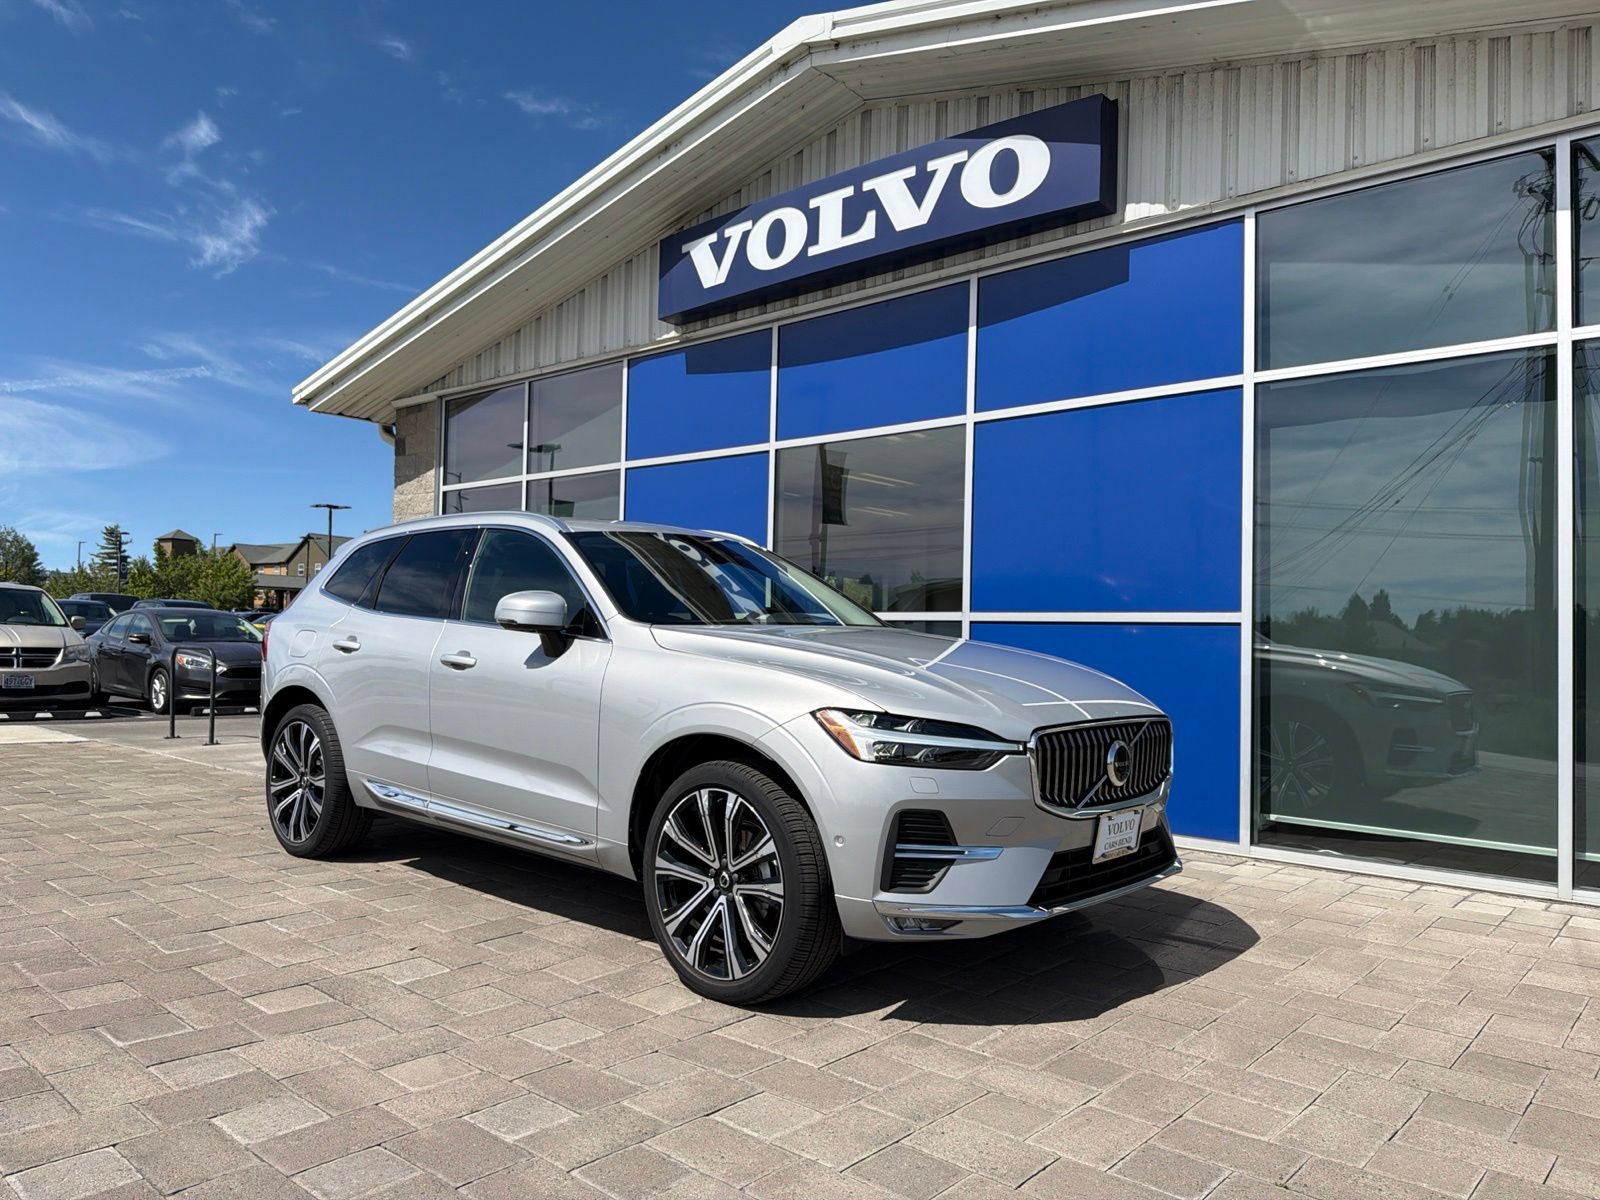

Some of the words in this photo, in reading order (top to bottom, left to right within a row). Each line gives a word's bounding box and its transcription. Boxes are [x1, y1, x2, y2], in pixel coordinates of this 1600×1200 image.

[681, 134, 1051, 289] VOLVO
[1107, 818, 1136, 836] VOLVO
[1104, 841, 1118, 851] CARS
